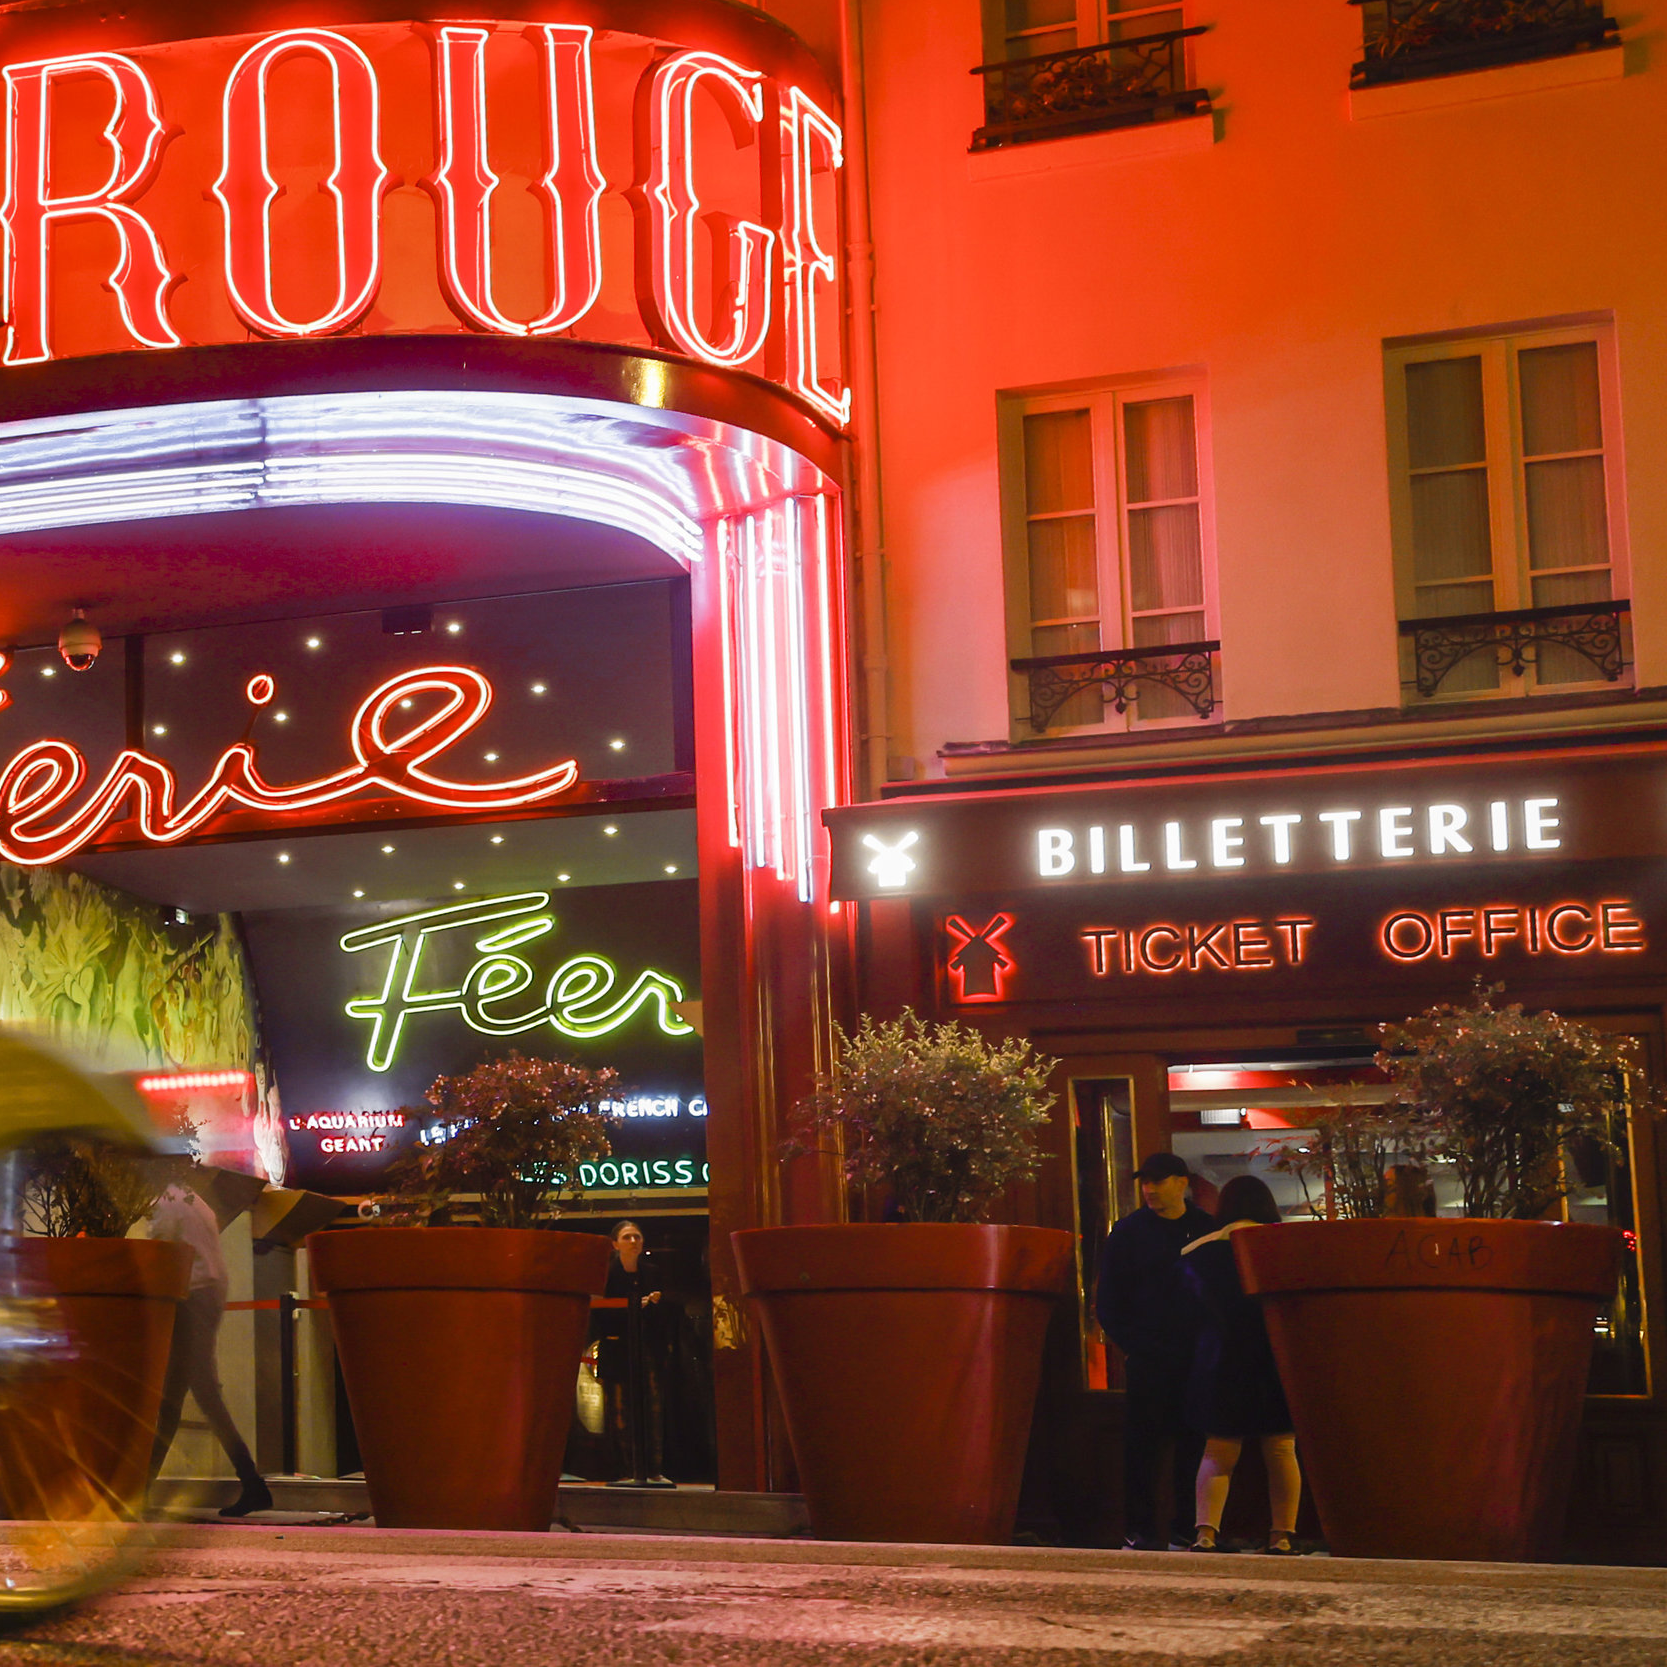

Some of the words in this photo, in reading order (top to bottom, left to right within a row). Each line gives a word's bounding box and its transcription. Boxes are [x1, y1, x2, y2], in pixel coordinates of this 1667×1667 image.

[1, 22, 853, 427] ROUGE
[1037, 798, 1562, 877] BILLETTERIE
[1081, 916, 1315, 976] TICKET
[1381, 898, 1647, 962] OFFICE
[598, 1098, 680, 1118] FRENCH
[579, 1160, 694, 1187] DORISS
[1385, 1229, 1493, 1270] ACAB
